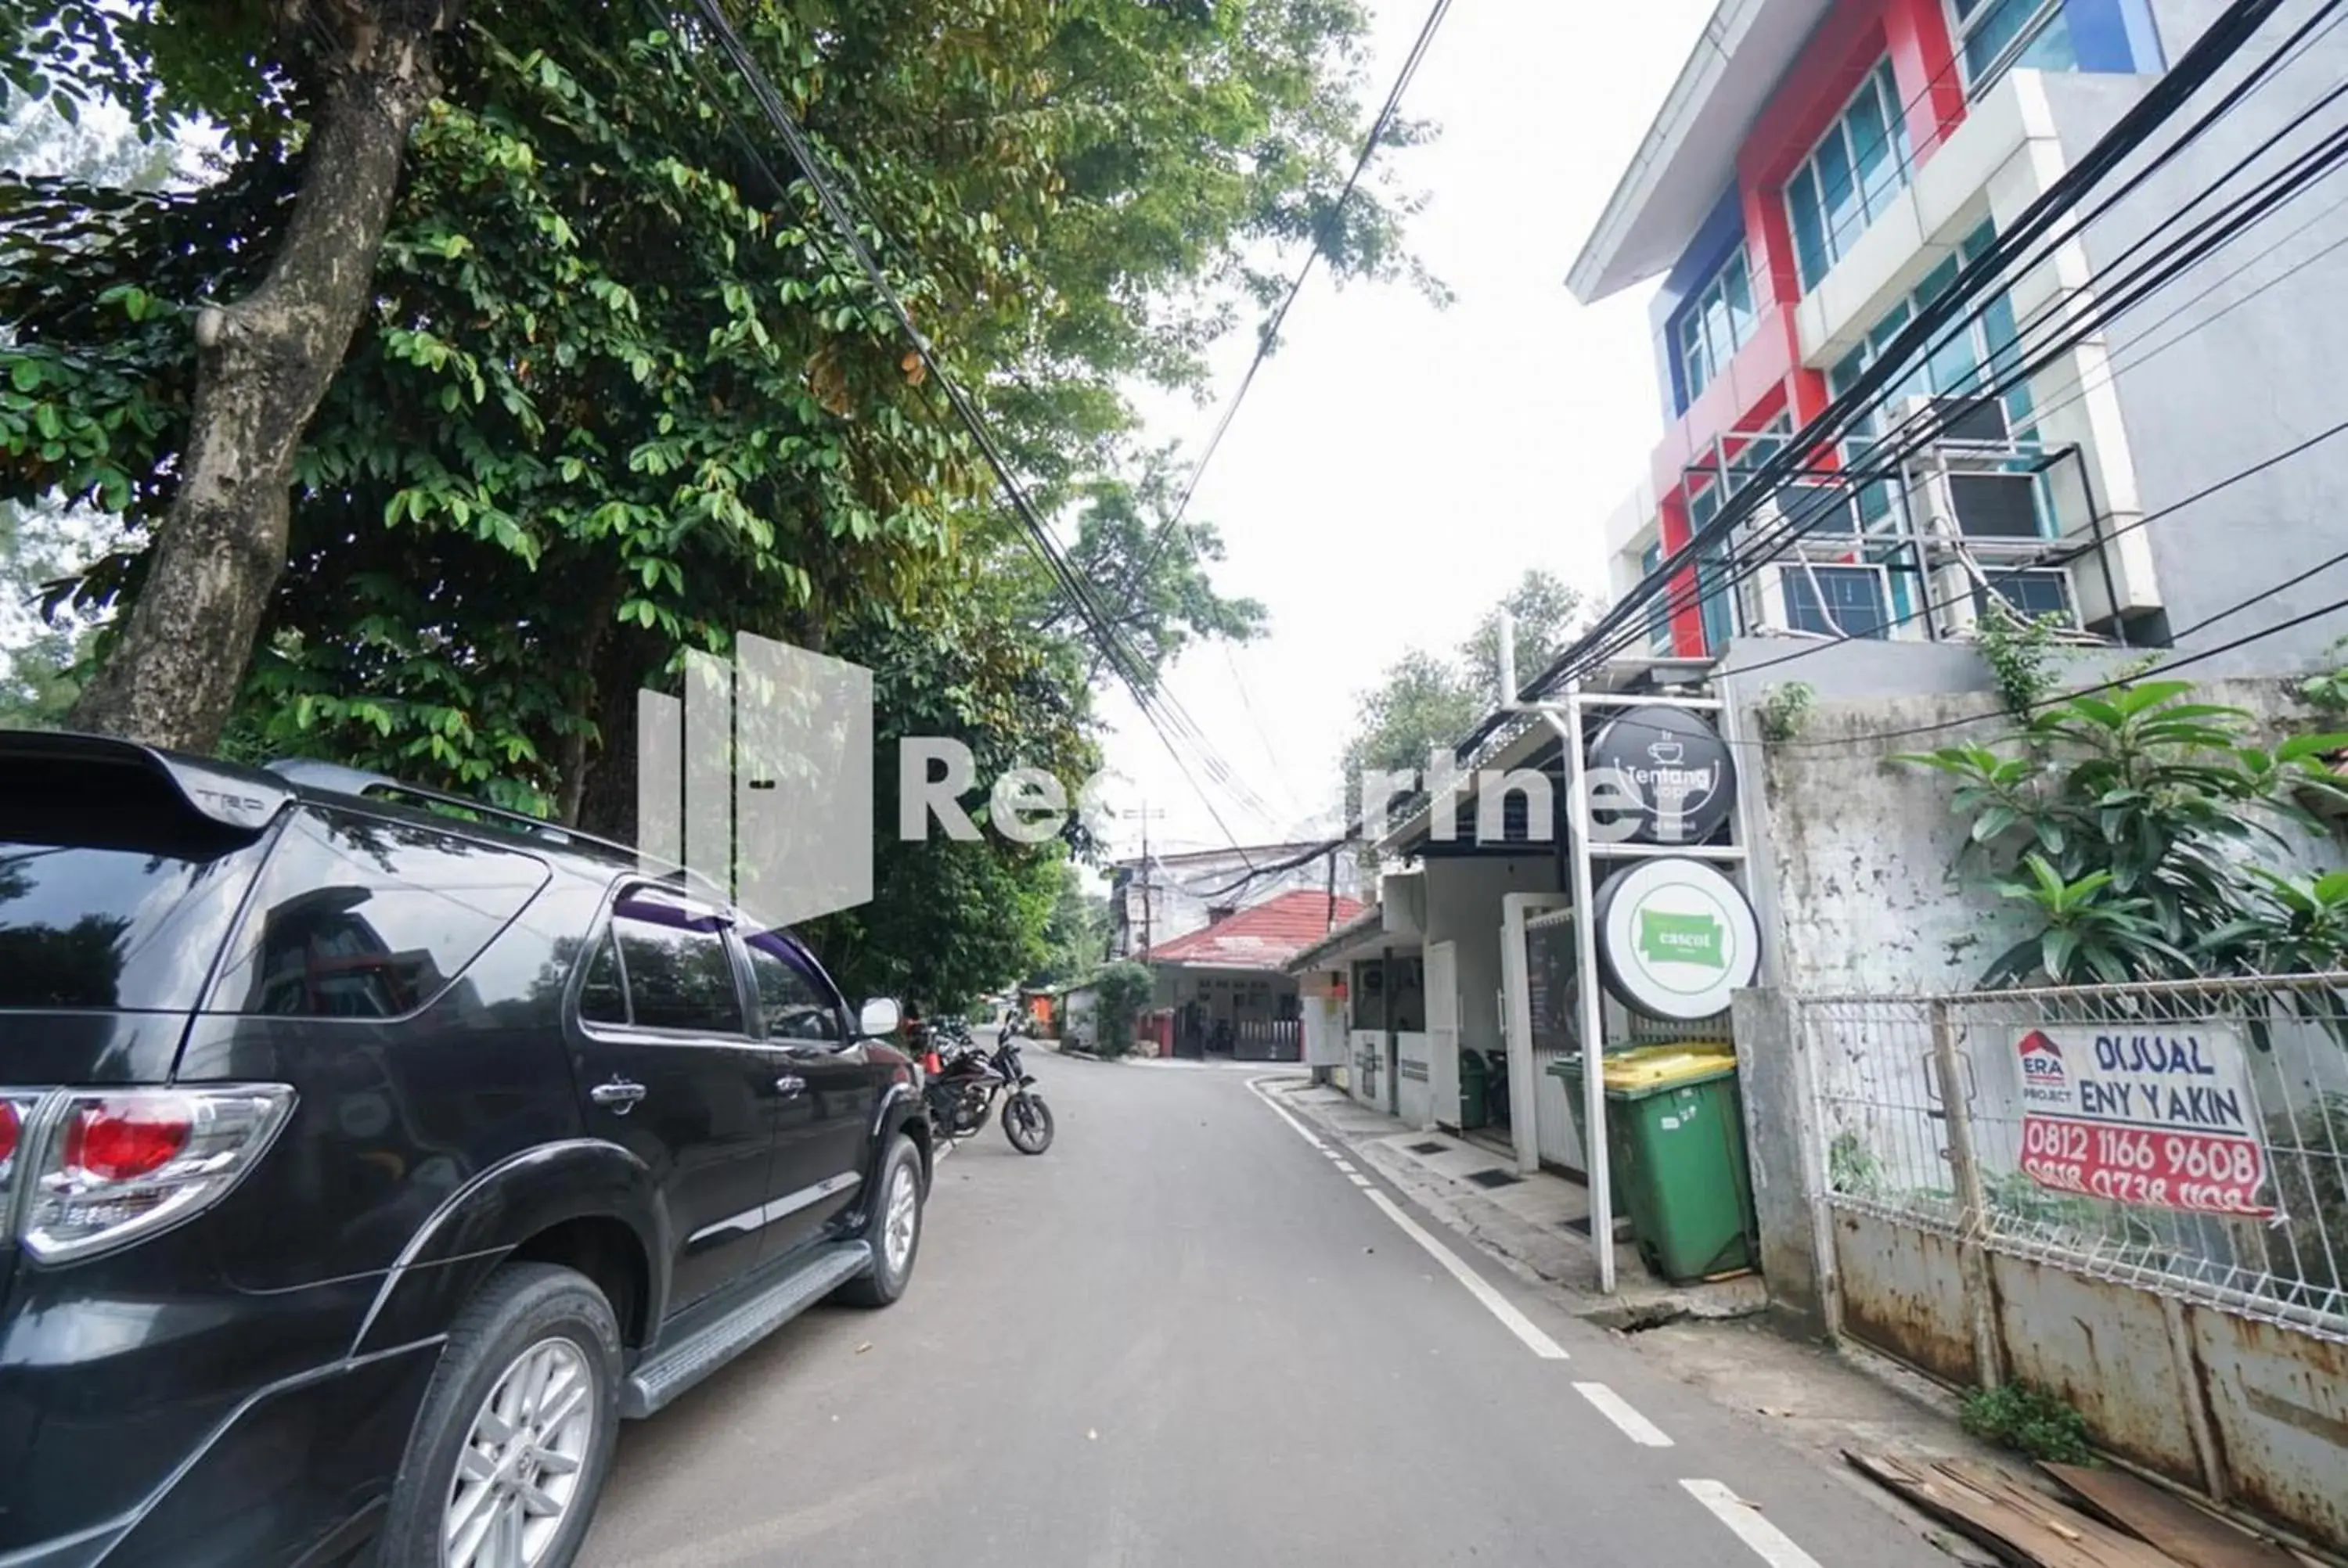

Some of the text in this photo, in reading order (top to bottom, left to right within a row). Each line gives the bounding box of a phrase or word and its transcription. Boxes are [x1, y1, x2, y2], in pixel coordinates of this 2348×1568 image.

[1626, 765, 1711, 792] Tentang
[2023, 1057, 2064, 1075] ERA
[2095, 1035, 2214, 1075] DIJUAL
[2023, 1088, 2073, 1102] PROJECT
[2079, 1080, 2131, 1117] ENY
[2026, 1123, 2256, 1184] 0812 1166 9608
